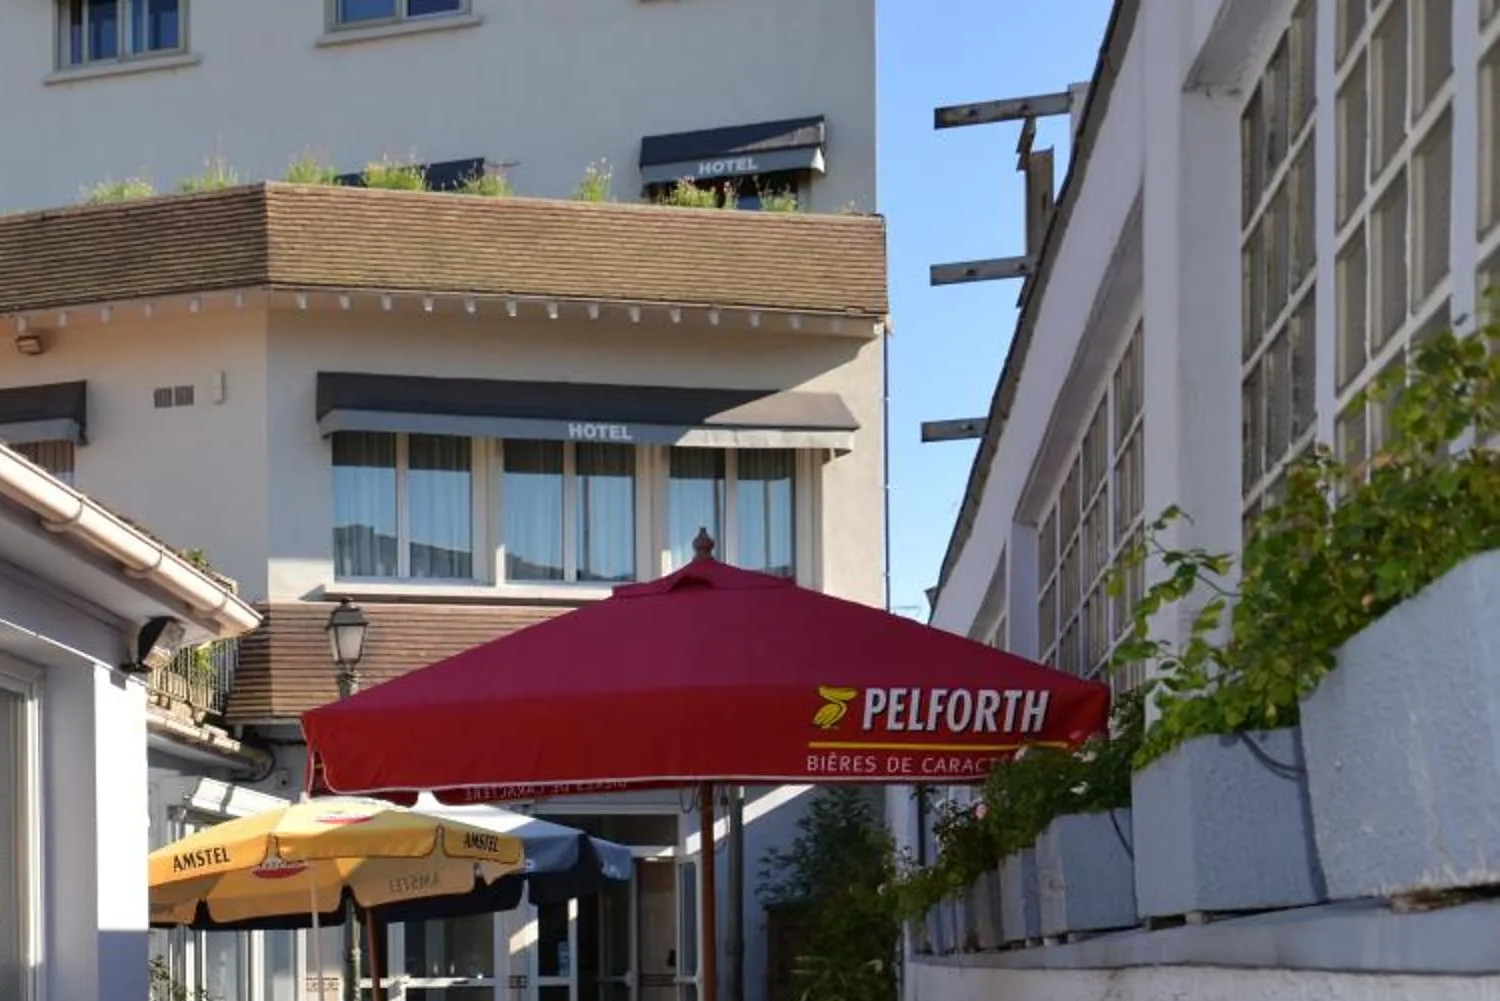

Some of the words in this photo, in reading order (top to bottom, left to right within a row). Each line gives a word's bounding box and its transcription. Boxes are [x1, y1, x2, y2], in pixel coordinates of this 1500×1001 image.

[698, 157, 758, 175] HOTEL
[567, 423, 633, 440] HOTEL
[862, 687, 1051, 733] PELFORTH
[806, 751, 878, 773] BIÈRES
[886, 756, 913, 773] DE
[463, 831, 499, 853] AMSTEL
[173, 846, 231, 872] AMSTEL
